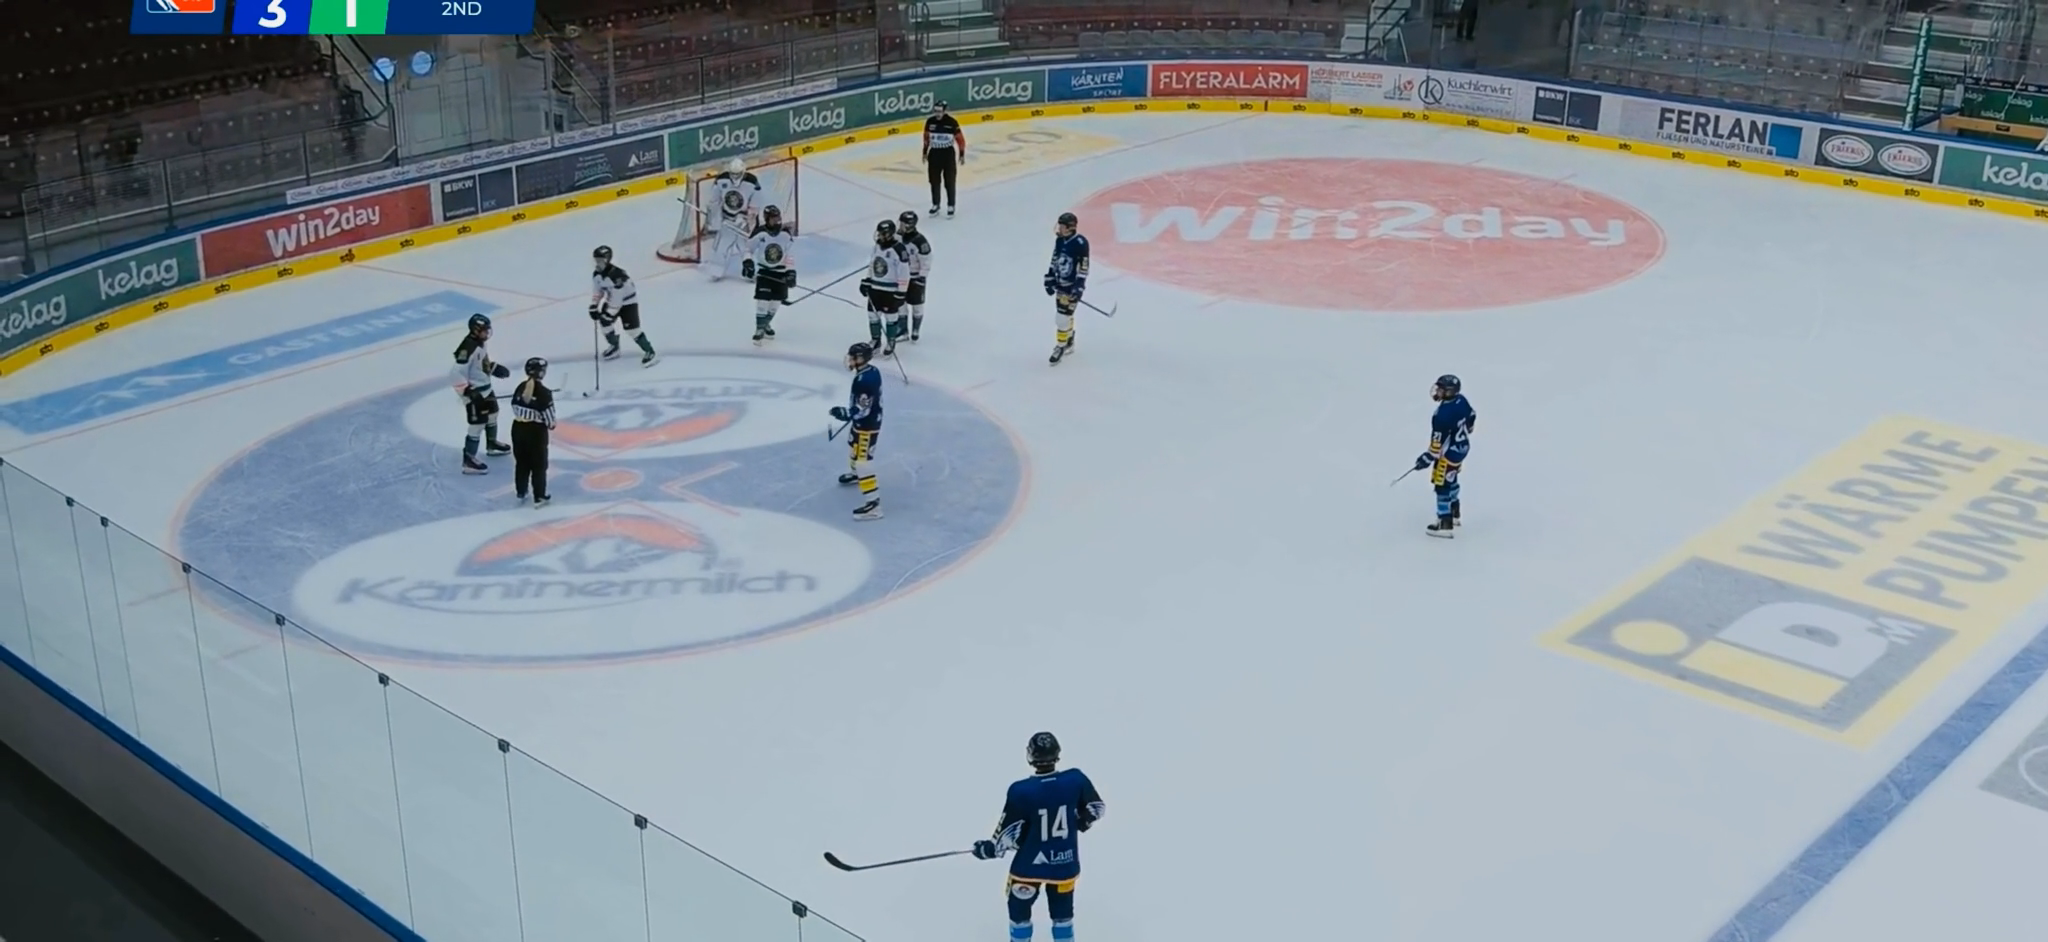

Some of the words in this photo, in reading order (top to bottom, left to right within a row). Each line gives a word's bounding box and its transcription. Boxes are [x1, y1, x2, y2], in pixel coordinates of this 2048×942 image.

[968, 77, 1033, 102] kelag
[1159, 71, 1301, 90] FLYERALARM
[875, 89, 935, 116] kelag
[789, 106, 846, 135] kelag
[1657, 106, 1769, 147] FERLAN
[700, 125, 760, 155] kelag
[1690, 136, 1708, 147] UND
[266, 205, 381, 258] win2day
[1110, 197, 1628, 248] win2day
[98, 257, 181, 301] kelag
[226, 301, 454, 367] GASTEINER
[1736, 428, 2002, 571] WÄRME
[1037, 804, 1070, 842] 14
[1050, 848, 1074, 862] Lam
